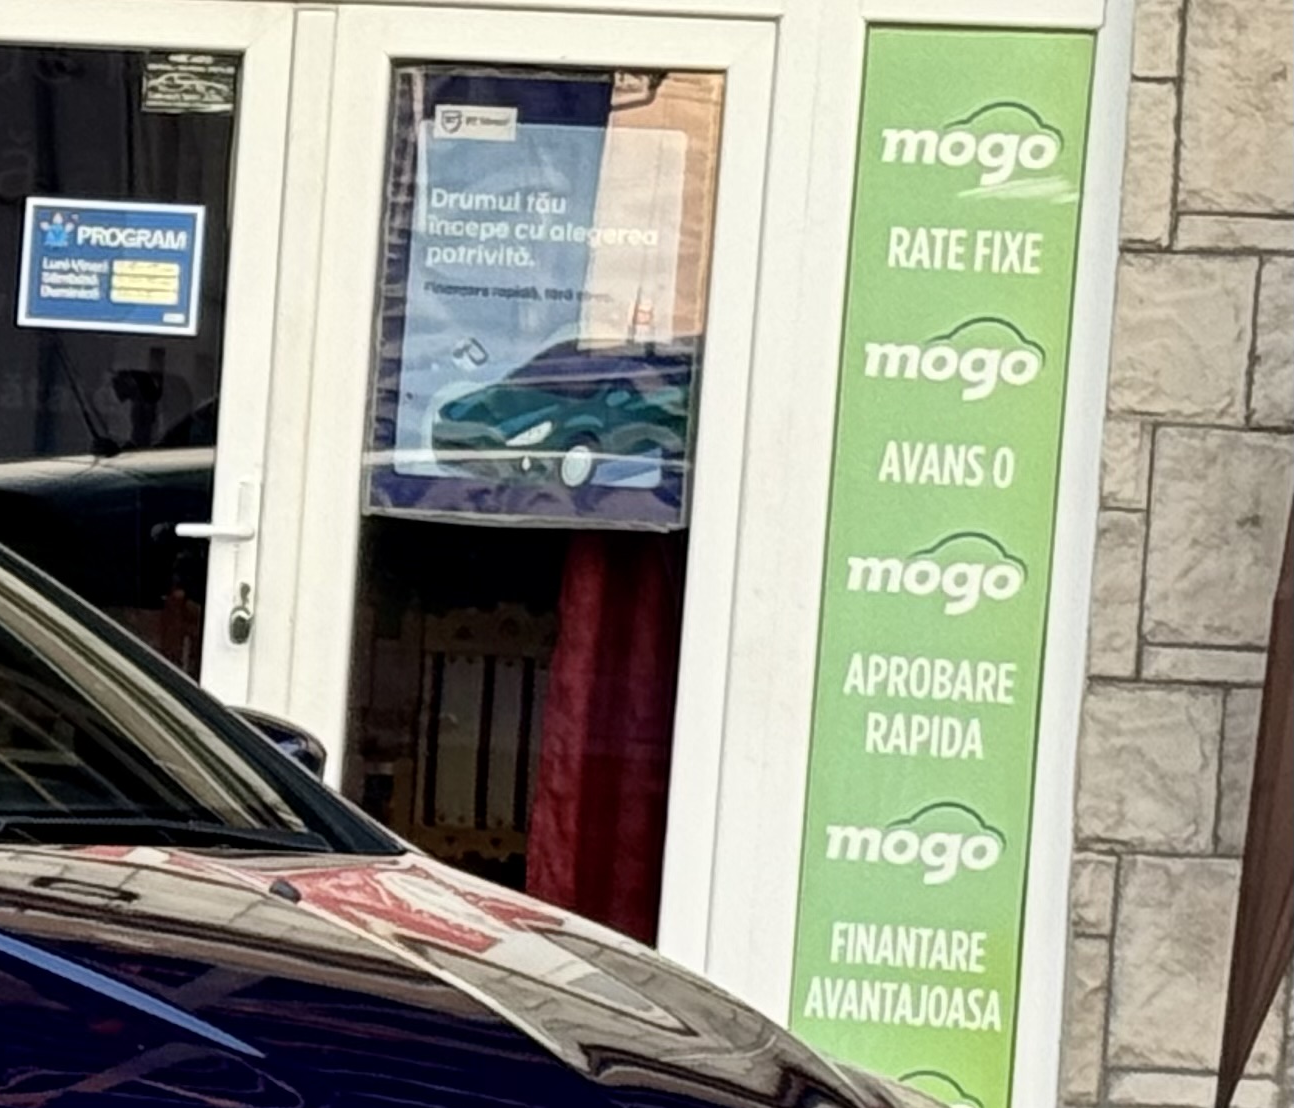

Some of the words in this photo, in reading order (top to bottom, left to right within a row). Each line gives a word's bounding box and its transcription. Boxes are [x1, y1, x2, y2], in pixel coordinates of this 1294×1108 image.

[881, 127, 1059, 187] mogo
[431, 188, 520, 213] Drumul
[527, 192, 566, 215] tău
[77, 226, 188, 250] PROGRAM
[425, 244, 536, 268] potrivită.
[427, 214, 510, 242] începe
[514, 221, 544, 241] cu
[549, 223, 658, 248] alegerea
[888, 227, 967, 271] RATE
[974, 230, 1044, 275] FIXE
[864, 341, 1042, 401] mogo
[878, 440, 985, 487] AVANS
[993, 446, 1015, 489] 0
[847, 555, 1023, 615] mogo
[843, 652, 1018, 706] APROBARE
[865, 712, 984, 761] RAPIDA
[825, 823, 1001, 885] mogo
[830, 920, 988, 975] FINANTARE
[804, 976, 1002, 1033] AVANTAJOASA
